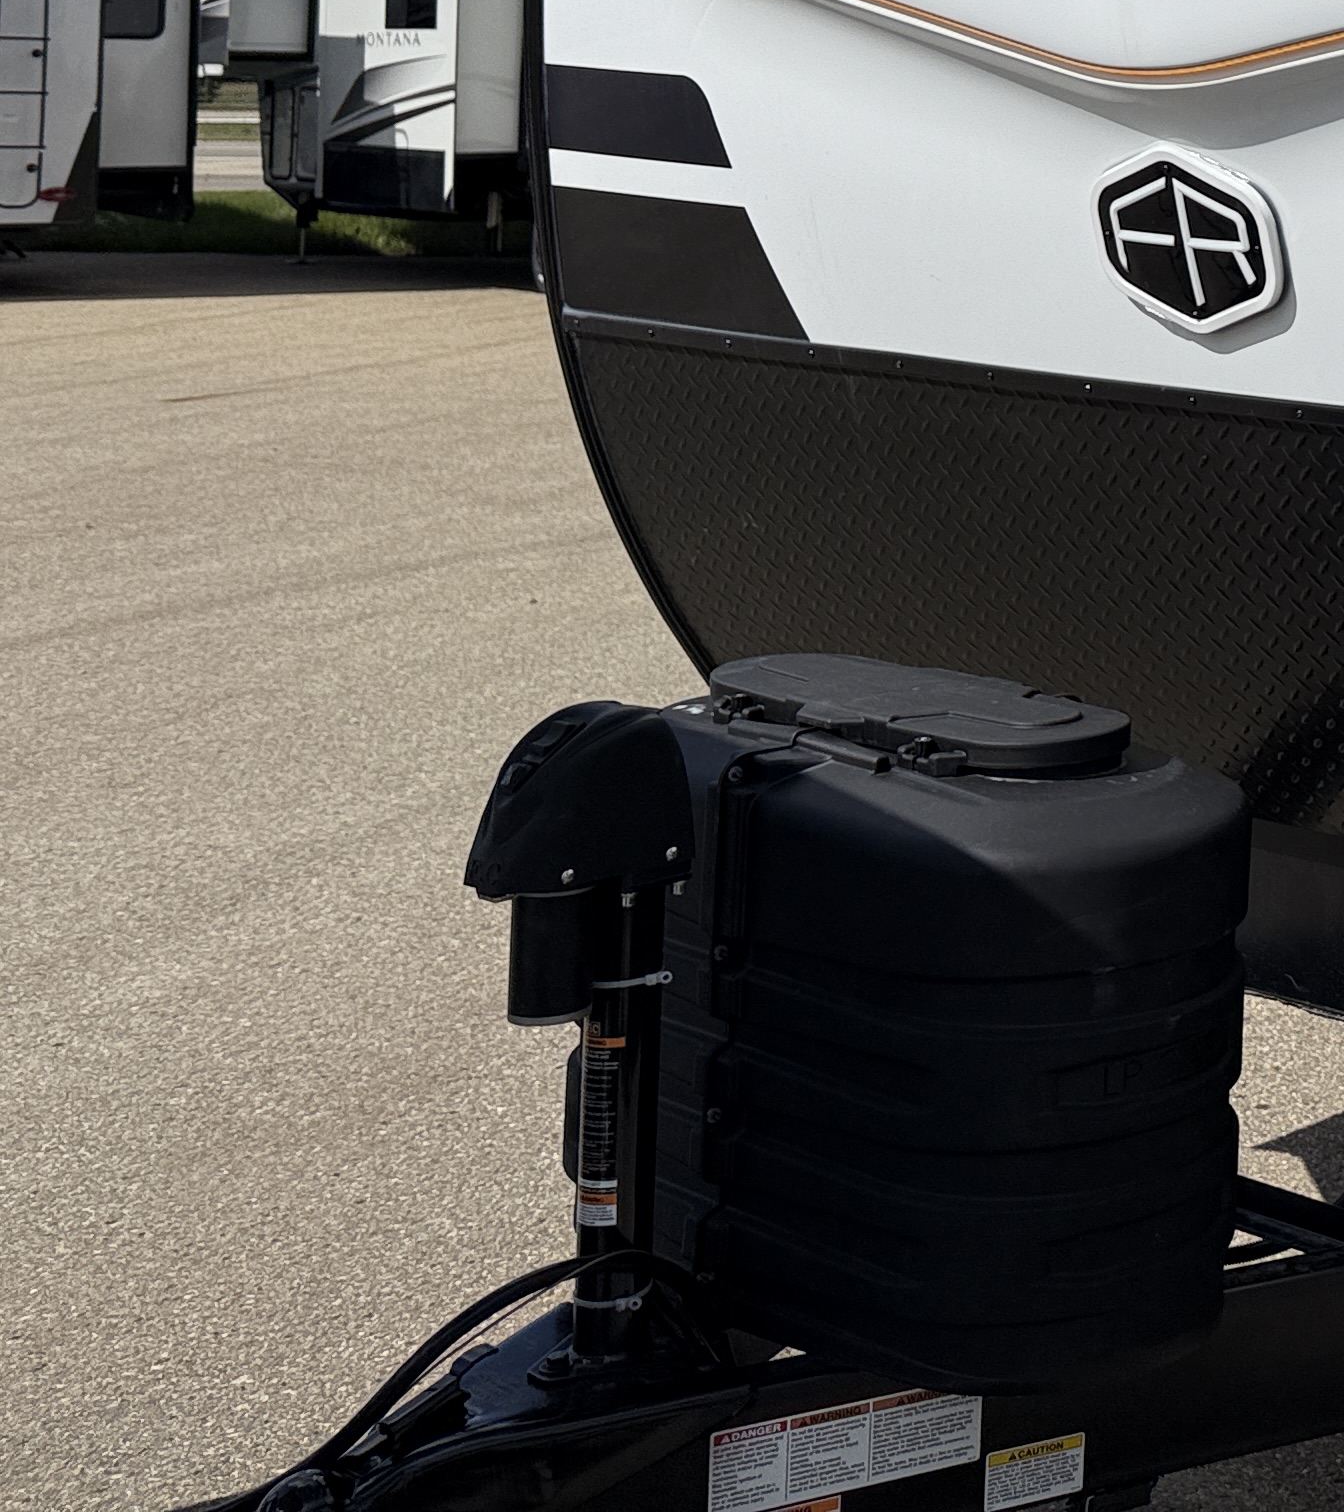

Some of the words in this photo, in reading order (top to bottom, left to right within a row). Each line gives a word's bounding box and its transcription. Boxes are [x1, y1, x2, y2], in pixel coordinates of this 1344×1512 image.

[356, 31, 421, 48] MONTANA
[809, 1405, 862, 1425] WARNING
[731, 1422, 782, 1441] DANGER
[1017, 1441, 1064, 1459] CAUTION
